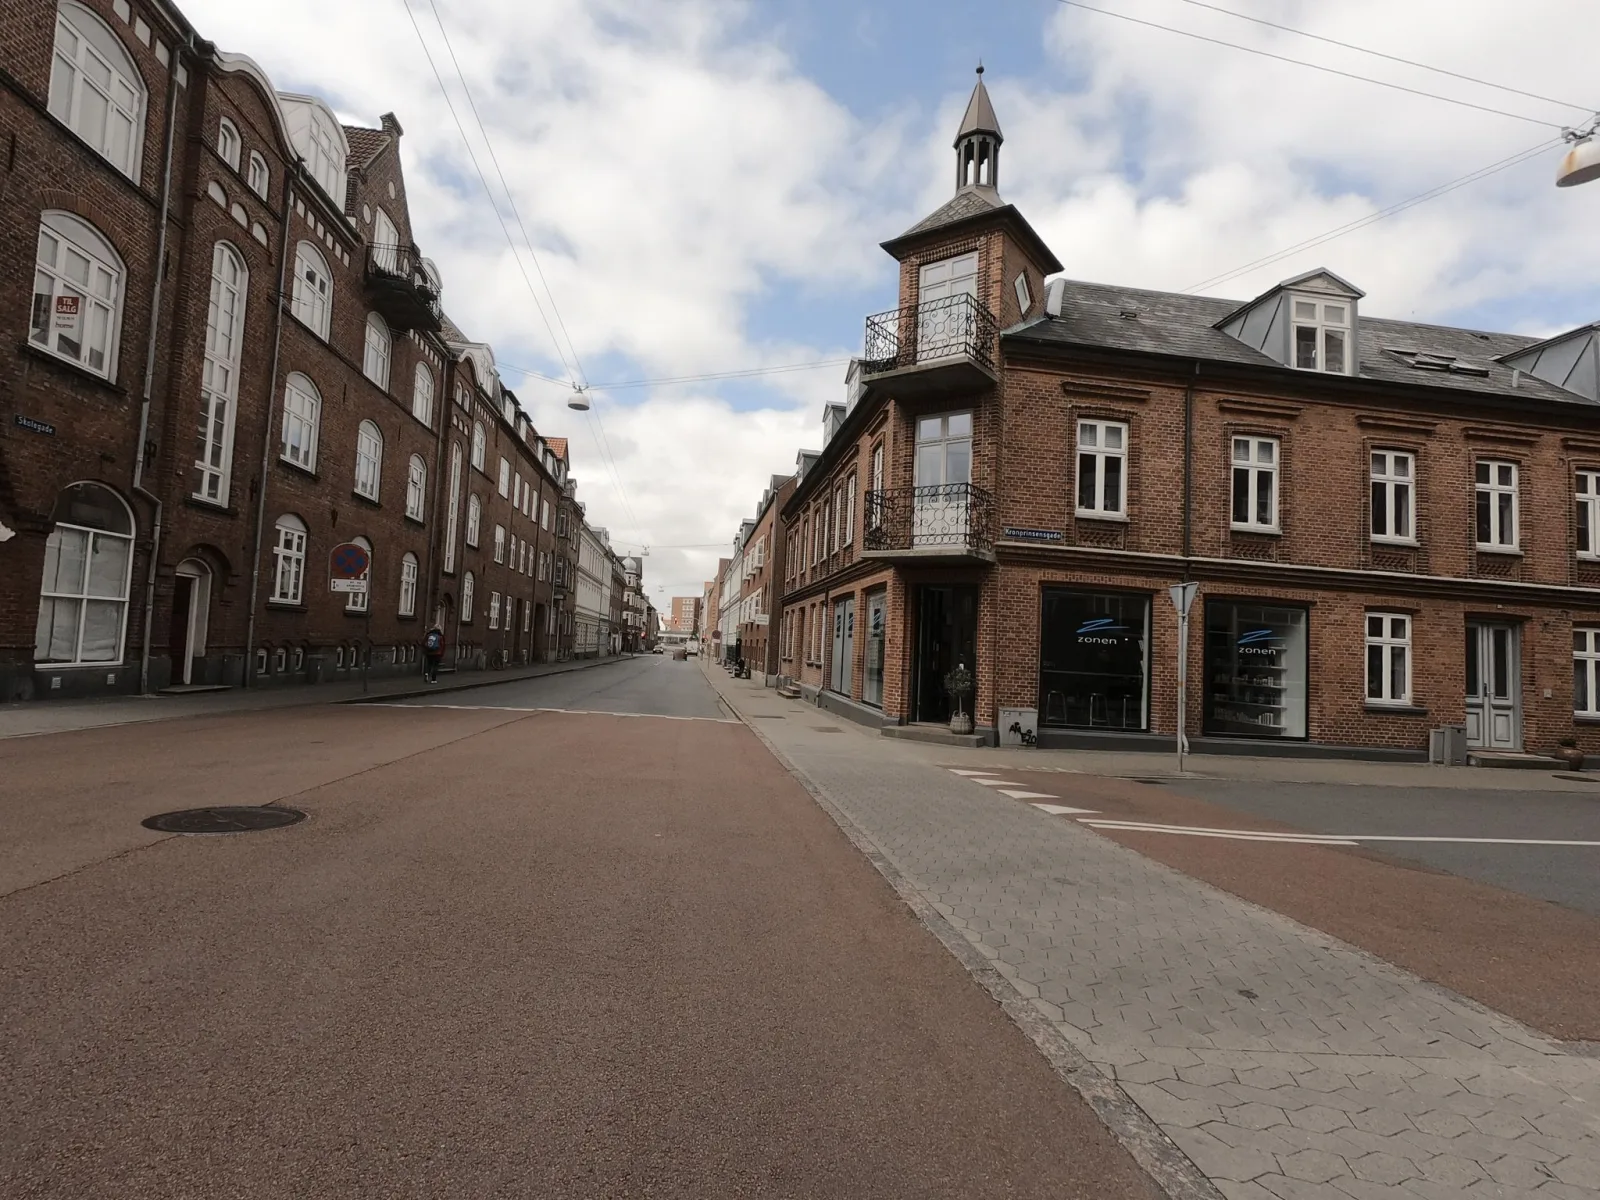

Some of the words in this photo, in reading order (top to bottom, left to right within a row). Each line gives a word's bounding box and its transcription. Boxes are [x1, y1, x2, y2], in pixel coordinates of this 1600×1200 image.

[57, 304, 77, 313] SALG
[18, 416, 53, 434] Skolegade
[1005, 528, 1061, 540] Kronprinsensgade
[1077, 636, 1117, 645] zonen
[1238, 646, 1276, 656] zonen
